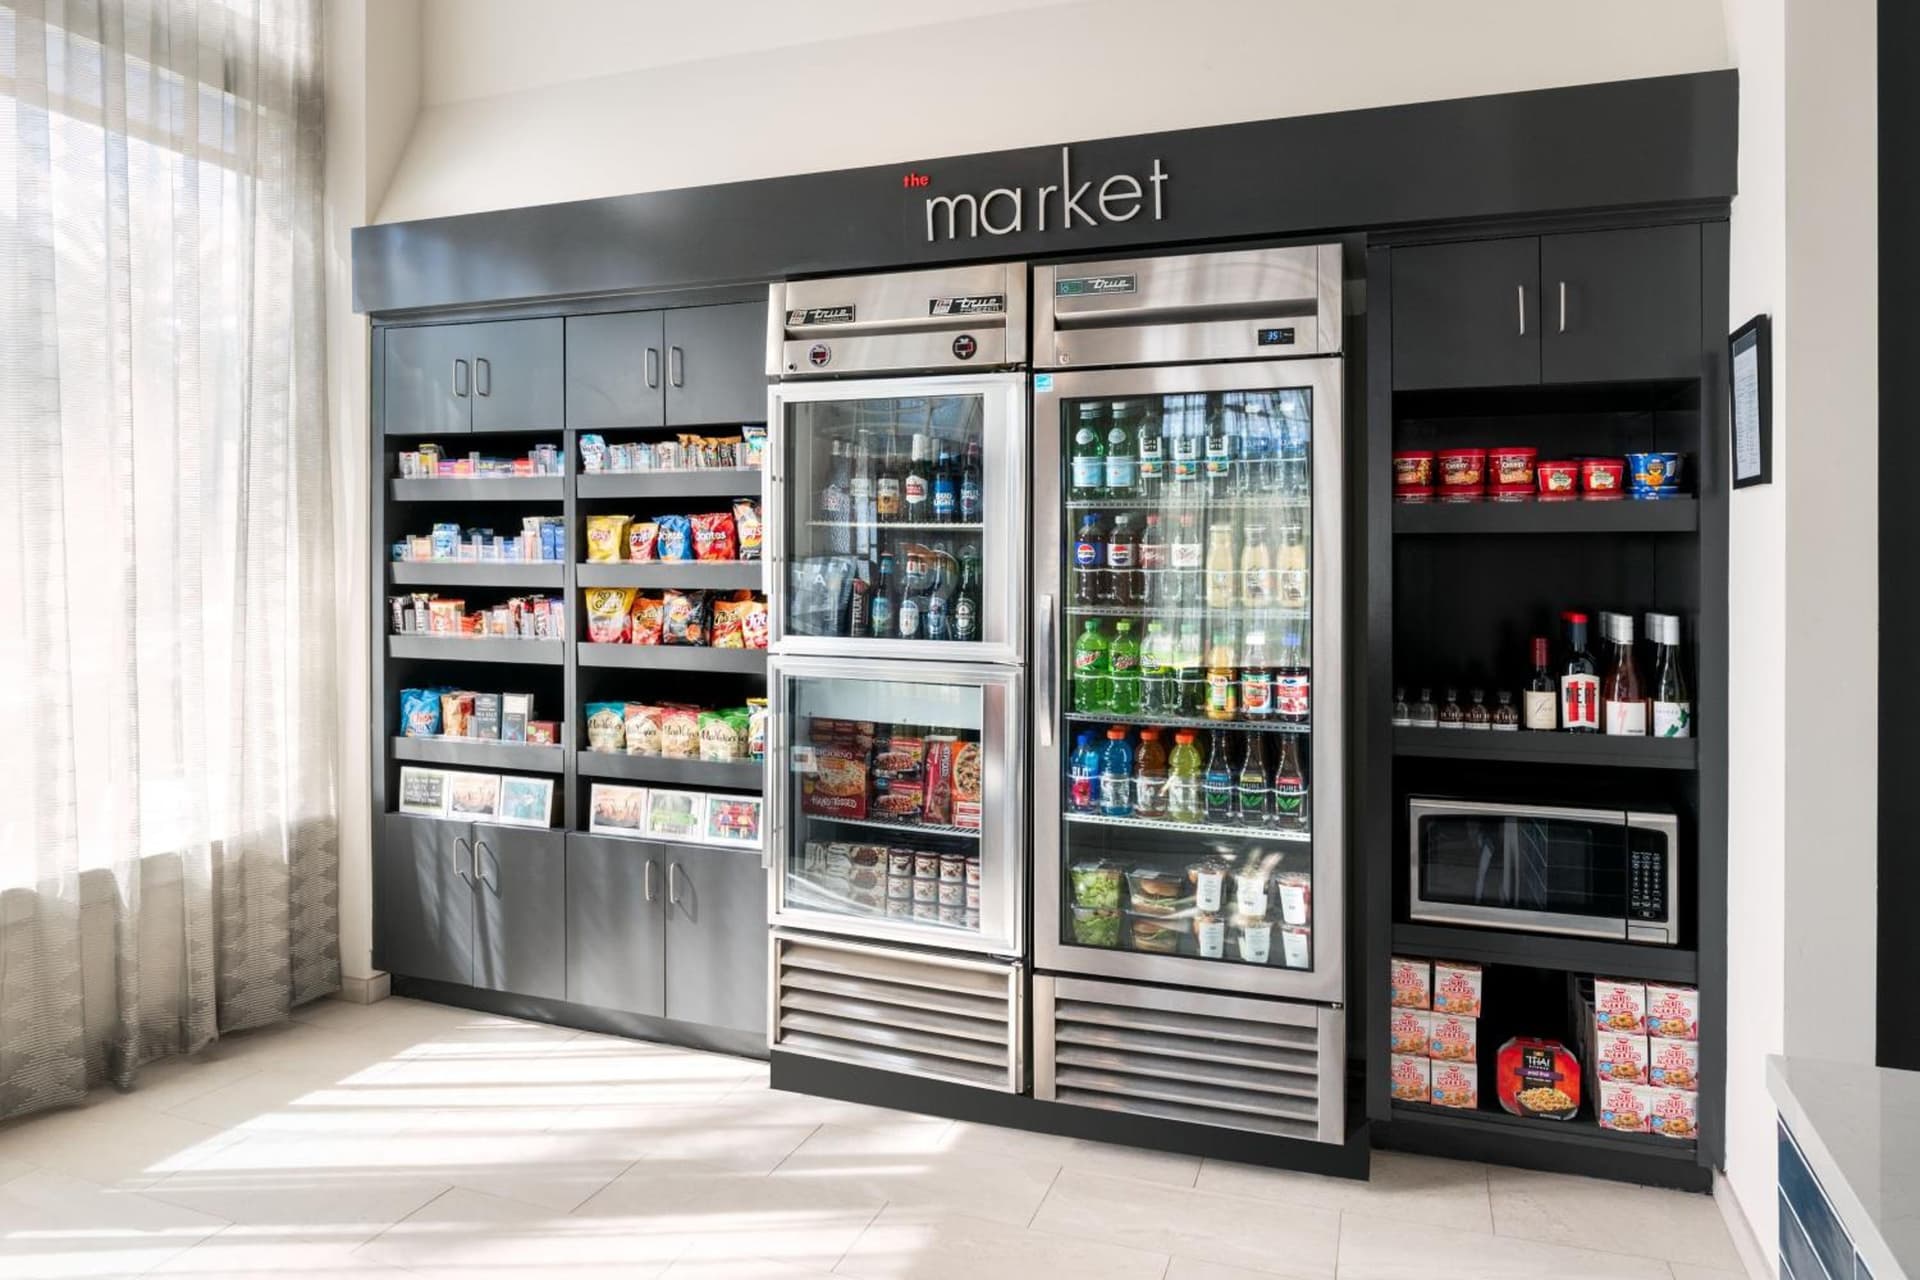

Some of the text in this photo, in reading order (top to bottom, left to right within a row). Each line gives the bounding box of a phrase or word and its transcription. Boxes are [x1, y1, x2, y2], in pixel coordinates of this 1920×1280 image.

[903, 173, 929, 188] the
[925, 146, 1169, 242] market
[1525, 1055, 1550, 1067] THAI
